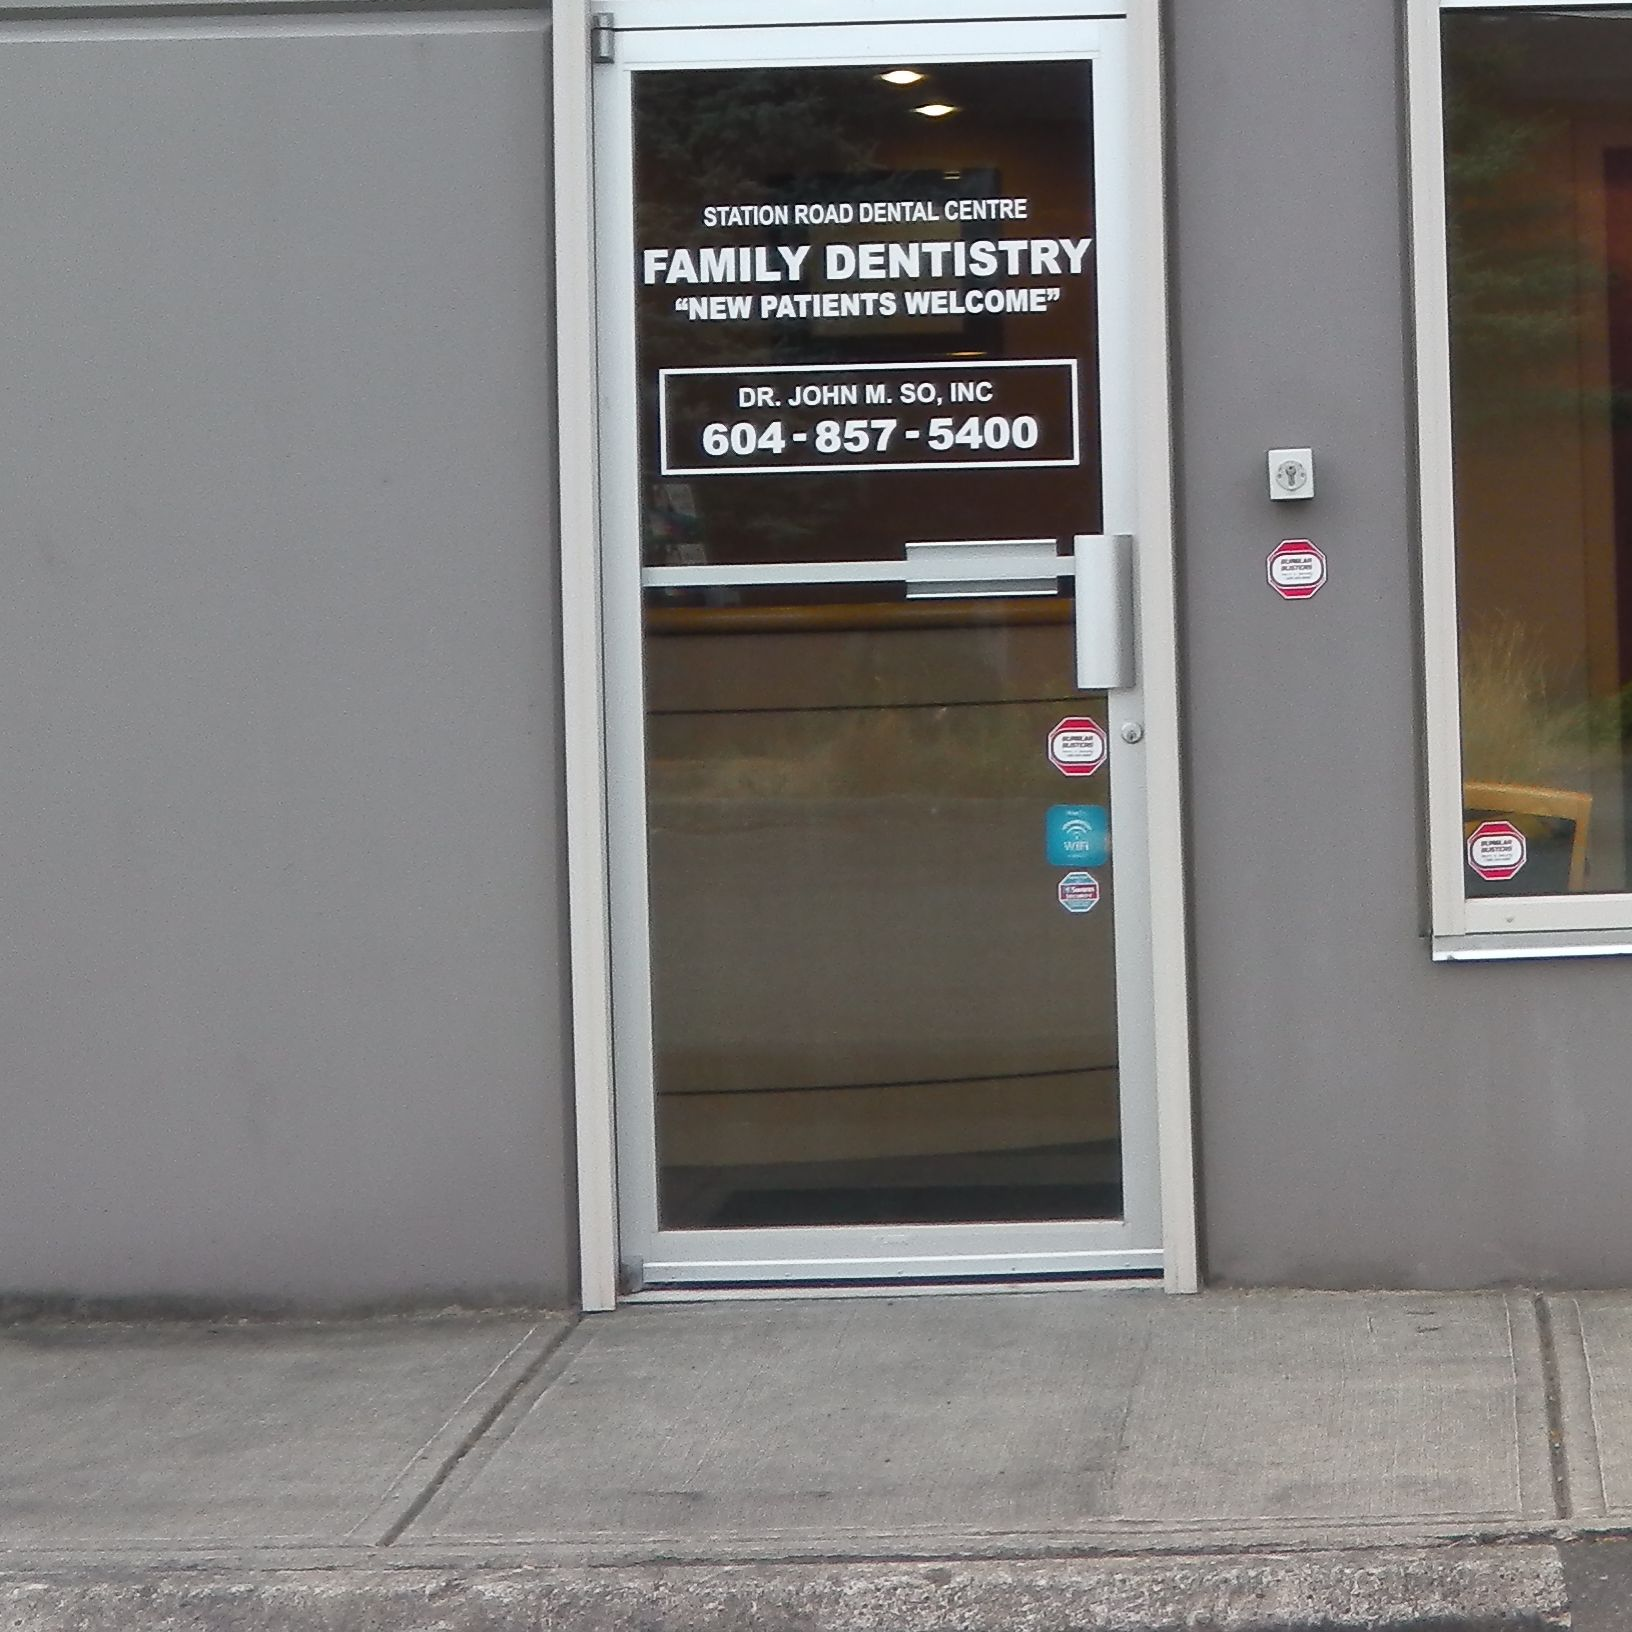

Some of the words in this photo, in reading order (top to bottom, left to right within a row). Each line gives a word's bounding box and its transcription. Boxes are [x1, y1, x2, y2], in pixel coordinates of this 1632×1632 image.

[703, 204, 789, 227] STATION
[794, 203, 854, 225] ROAD
[859, 200, 941, 223] DENTAL
[944, 198, 1028, 221] CENTRE
[643, 245, 811, 285] FAMILY
[825, 238, 1093, 280] DENTISTRY
[760, 291, 897, 319] PATIENTS
[738, 386, 782, 408] DR.
[787, 384, 858, 407] JOHN
[865, 383, 893, 405] M.
[899, 382, 943, 406] SO,
[949, 381, 994, 403] INC
